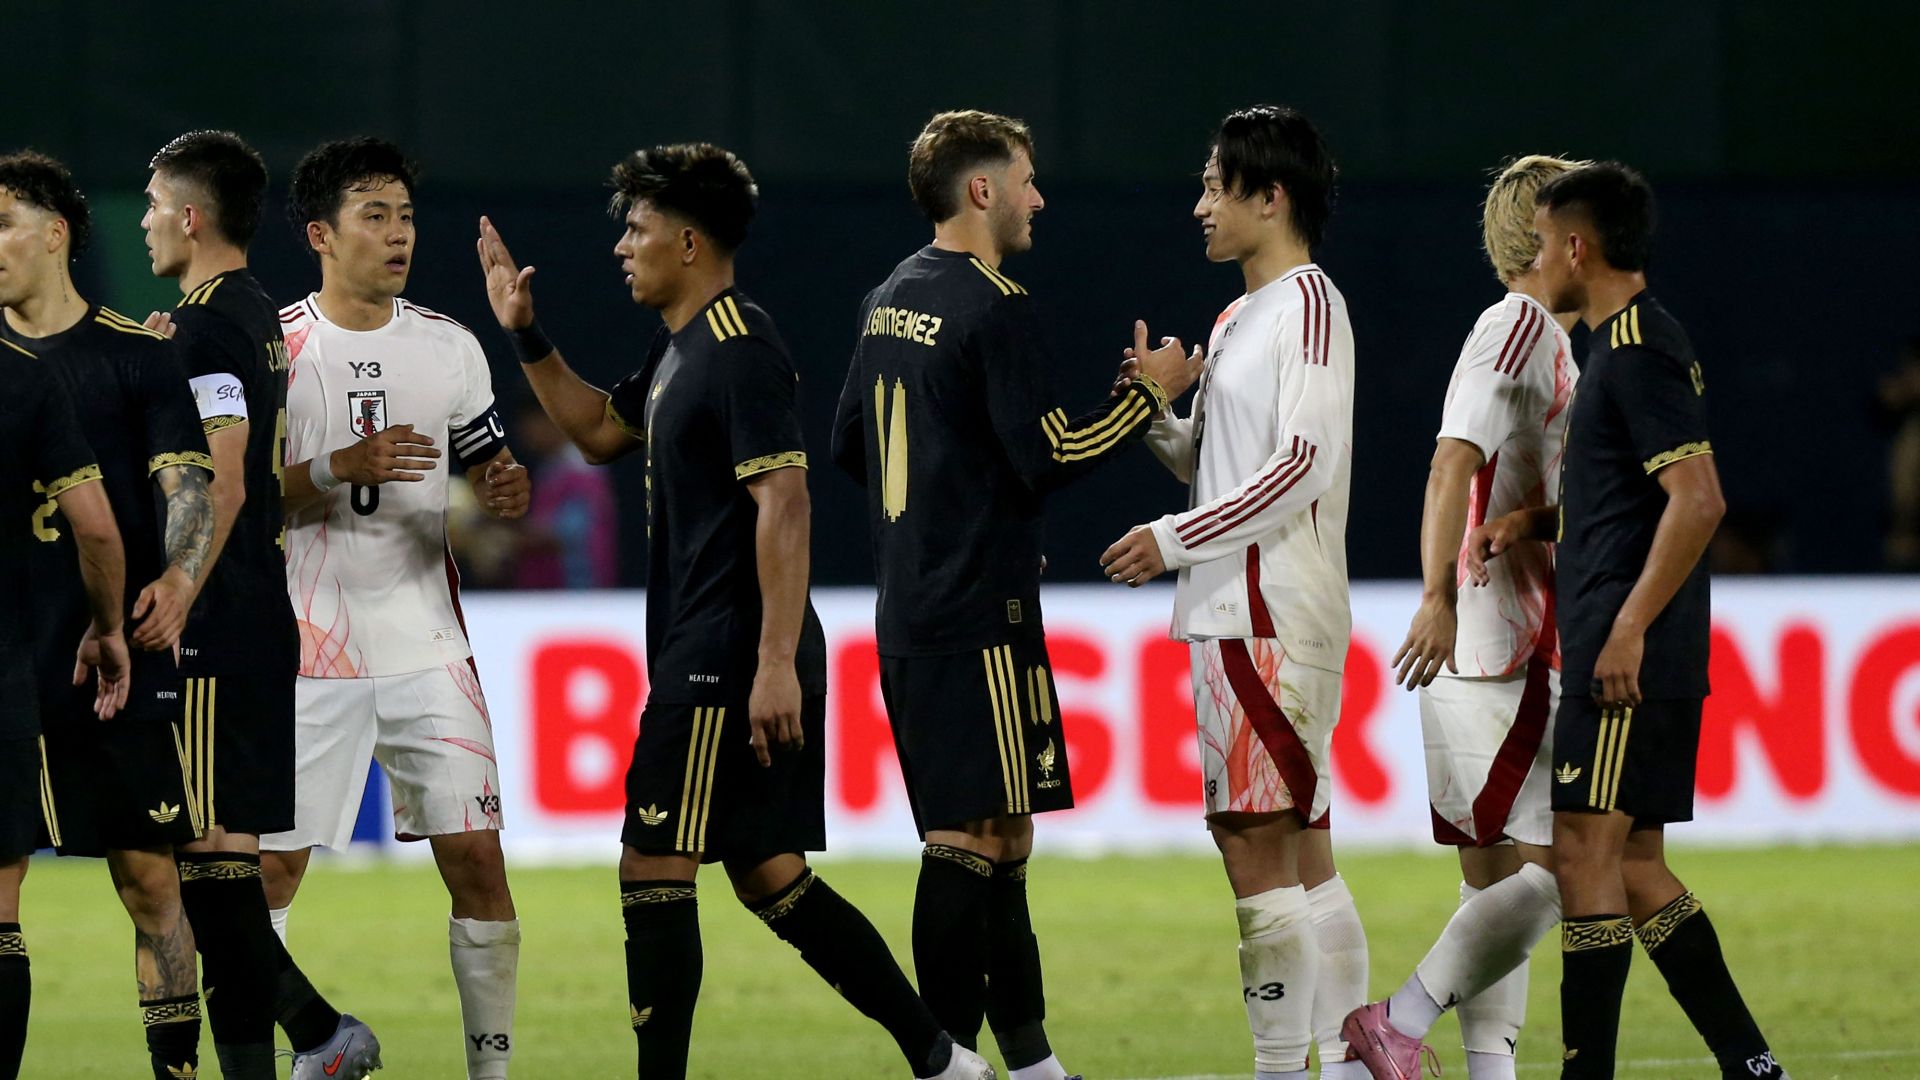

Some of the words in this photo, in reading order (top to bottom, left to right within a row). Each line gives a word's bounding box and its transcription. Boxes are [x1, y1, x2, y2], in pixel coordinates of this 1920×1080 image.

[348, 361, 382, 378] Y-3
[475, 795, 499, 813] Y-3
[470, 1033, 510, 1051] Y-3
